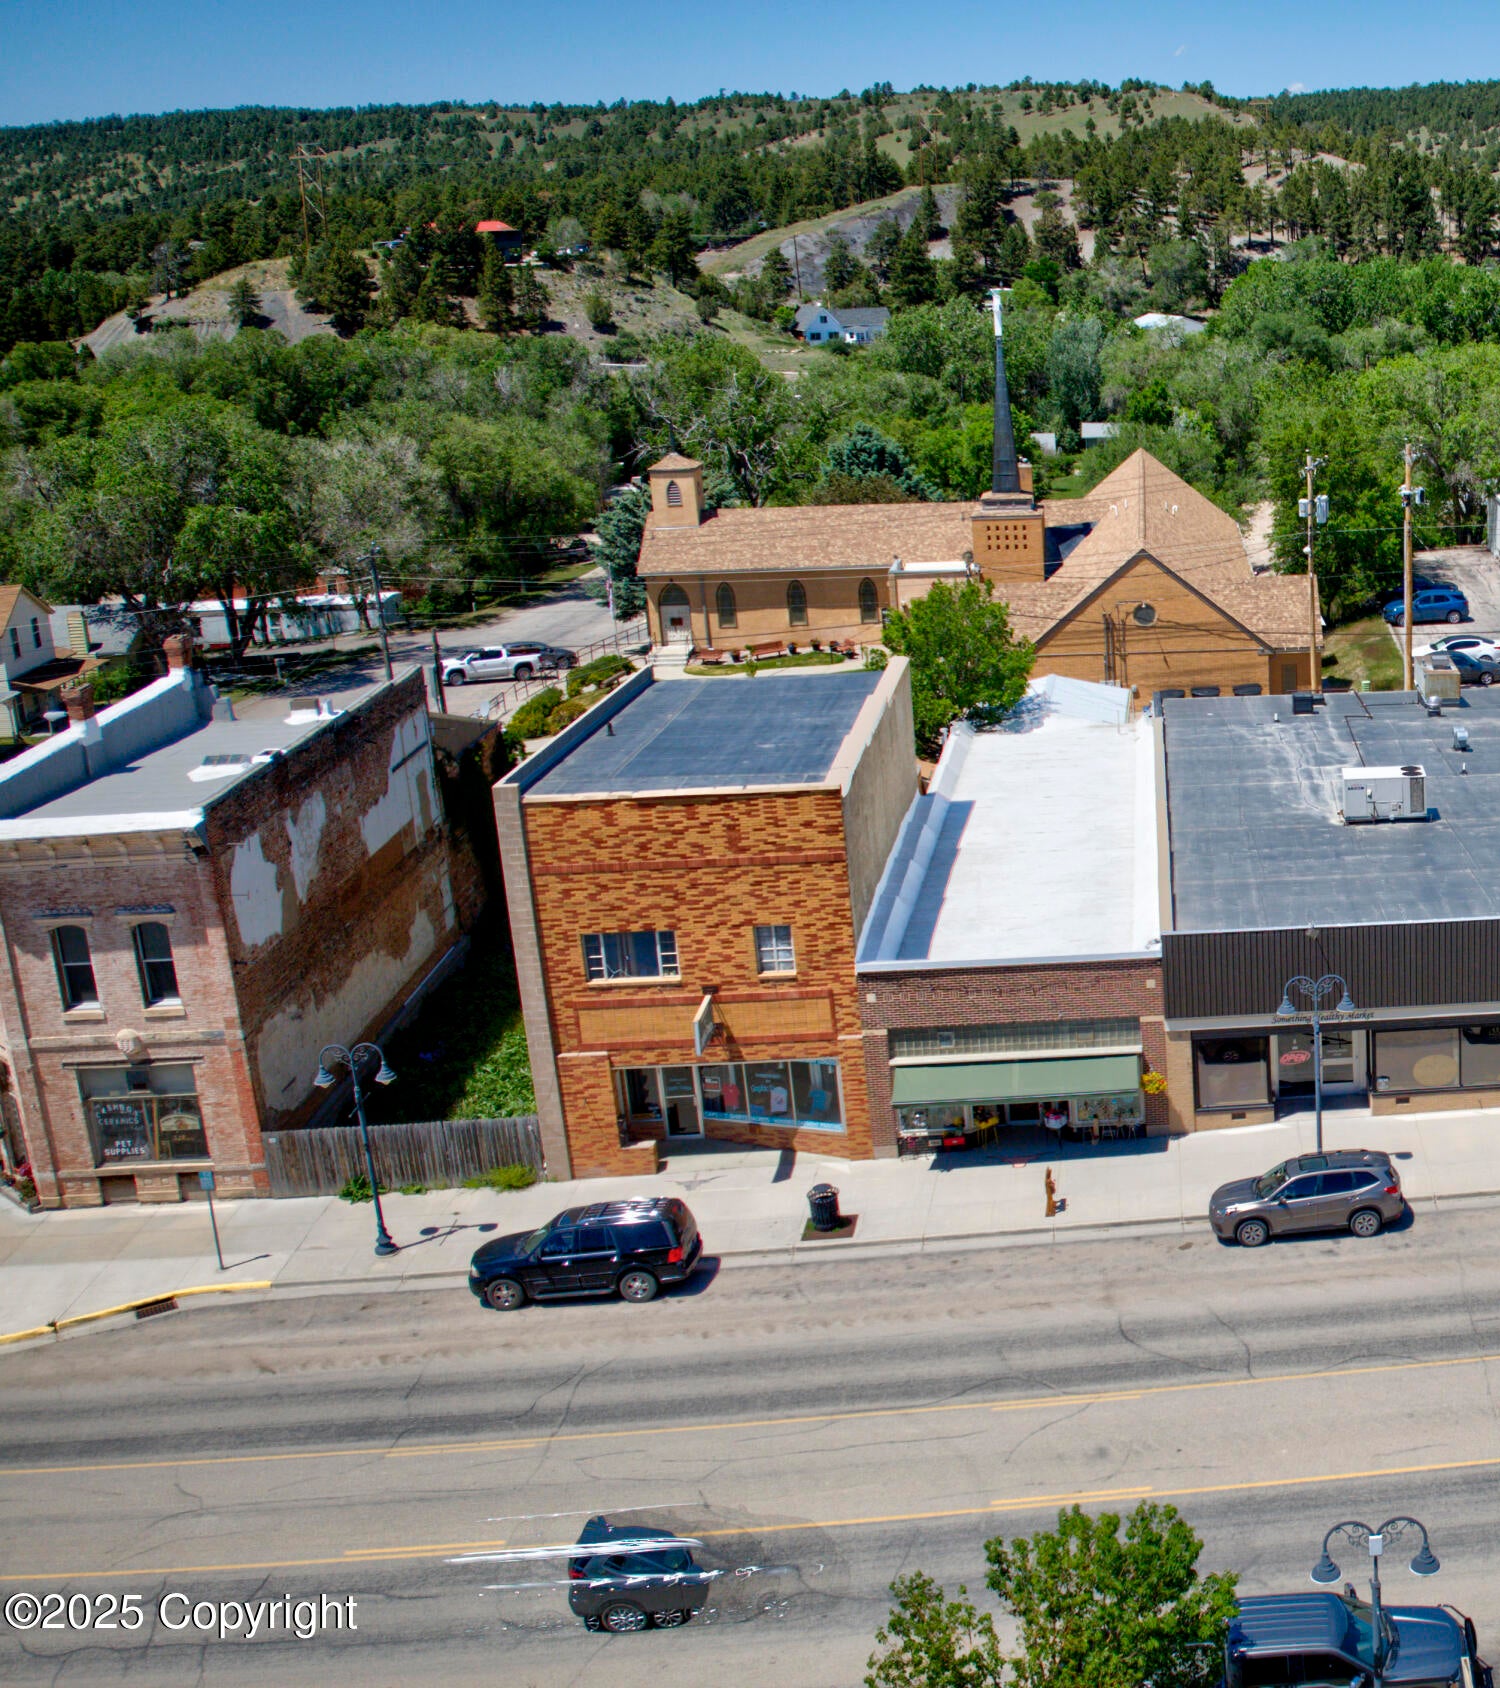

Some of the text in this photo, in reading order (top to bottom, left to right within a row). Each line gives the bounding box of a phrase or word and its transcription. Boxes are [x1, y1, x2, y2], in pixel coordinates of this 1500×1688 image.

[1318, 1012, 1344, 1023] ealthy
[1281, 1053, 1308, 1063] OPEN
[104, 1147, 146, 1156] SUPPLIES
